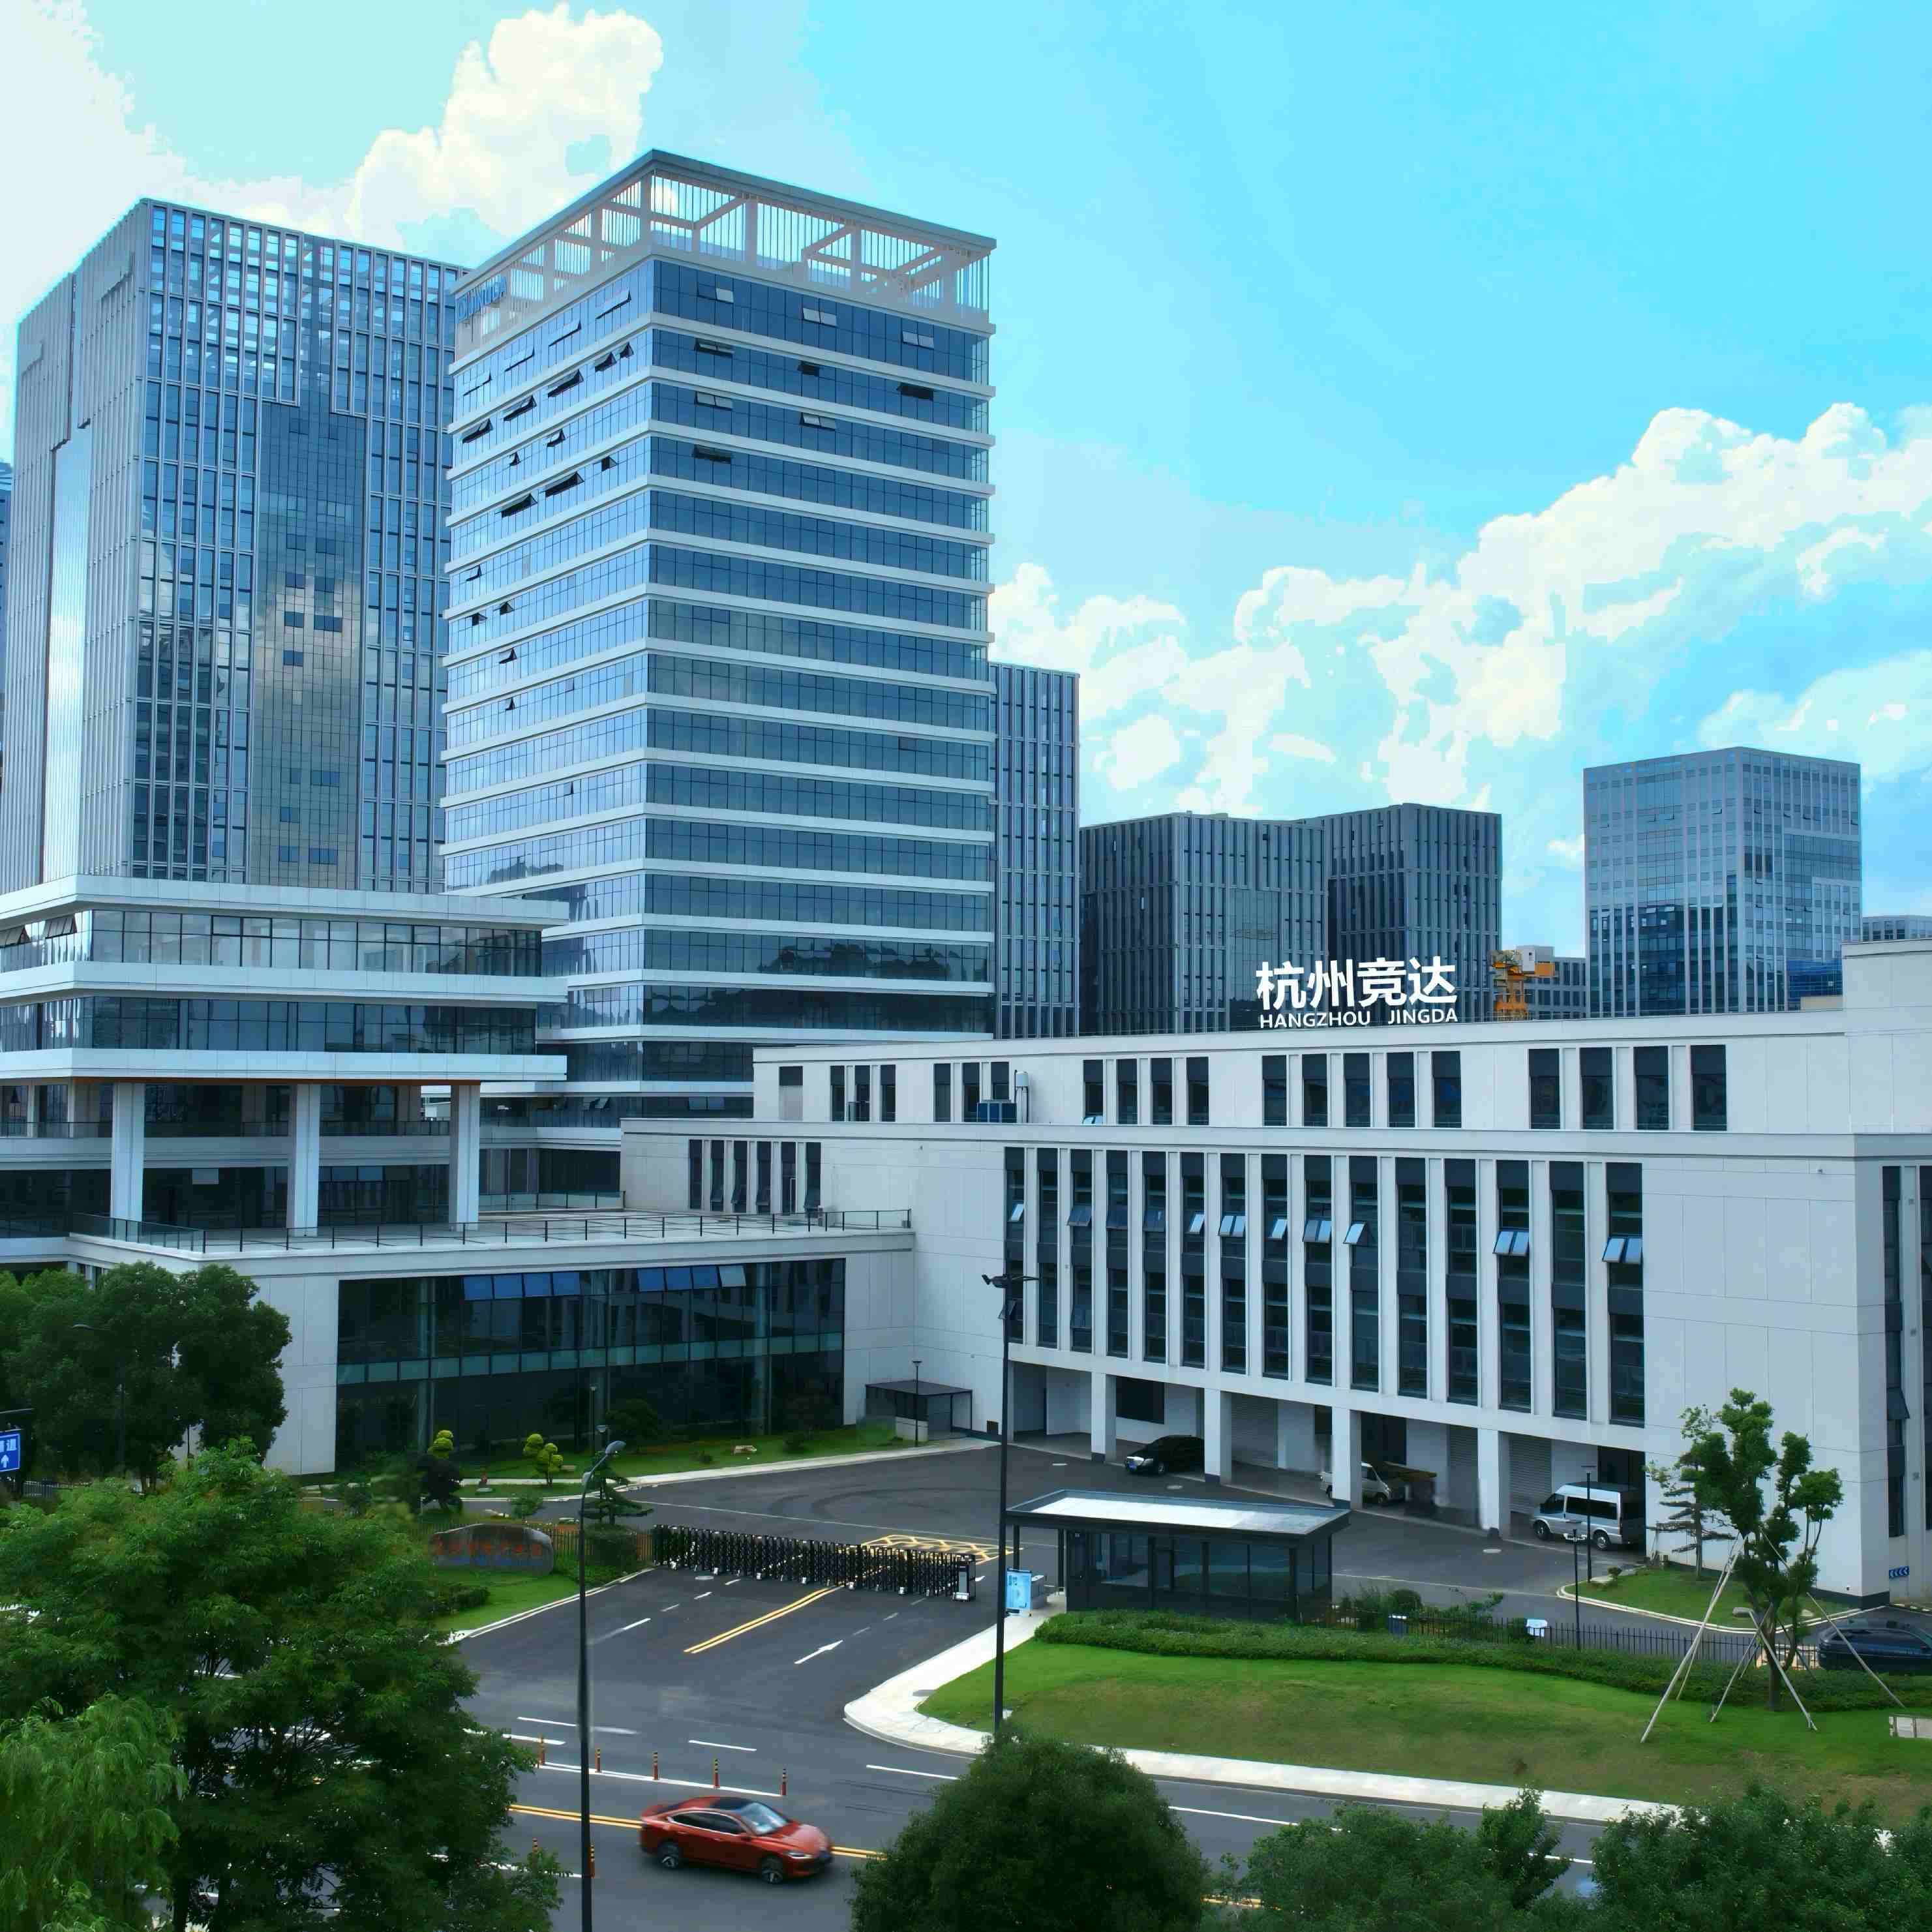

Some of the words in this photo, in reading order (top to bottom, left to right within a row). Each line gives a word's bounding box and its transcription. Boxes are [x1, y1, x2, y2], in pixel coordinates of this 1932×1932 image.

[1256, 956, 1457, 1010] 杭州竞达
[1260, 1012, 1370, 1029] HANGZHOU
[1387, 1008, 1458, 1024] JINGDA
